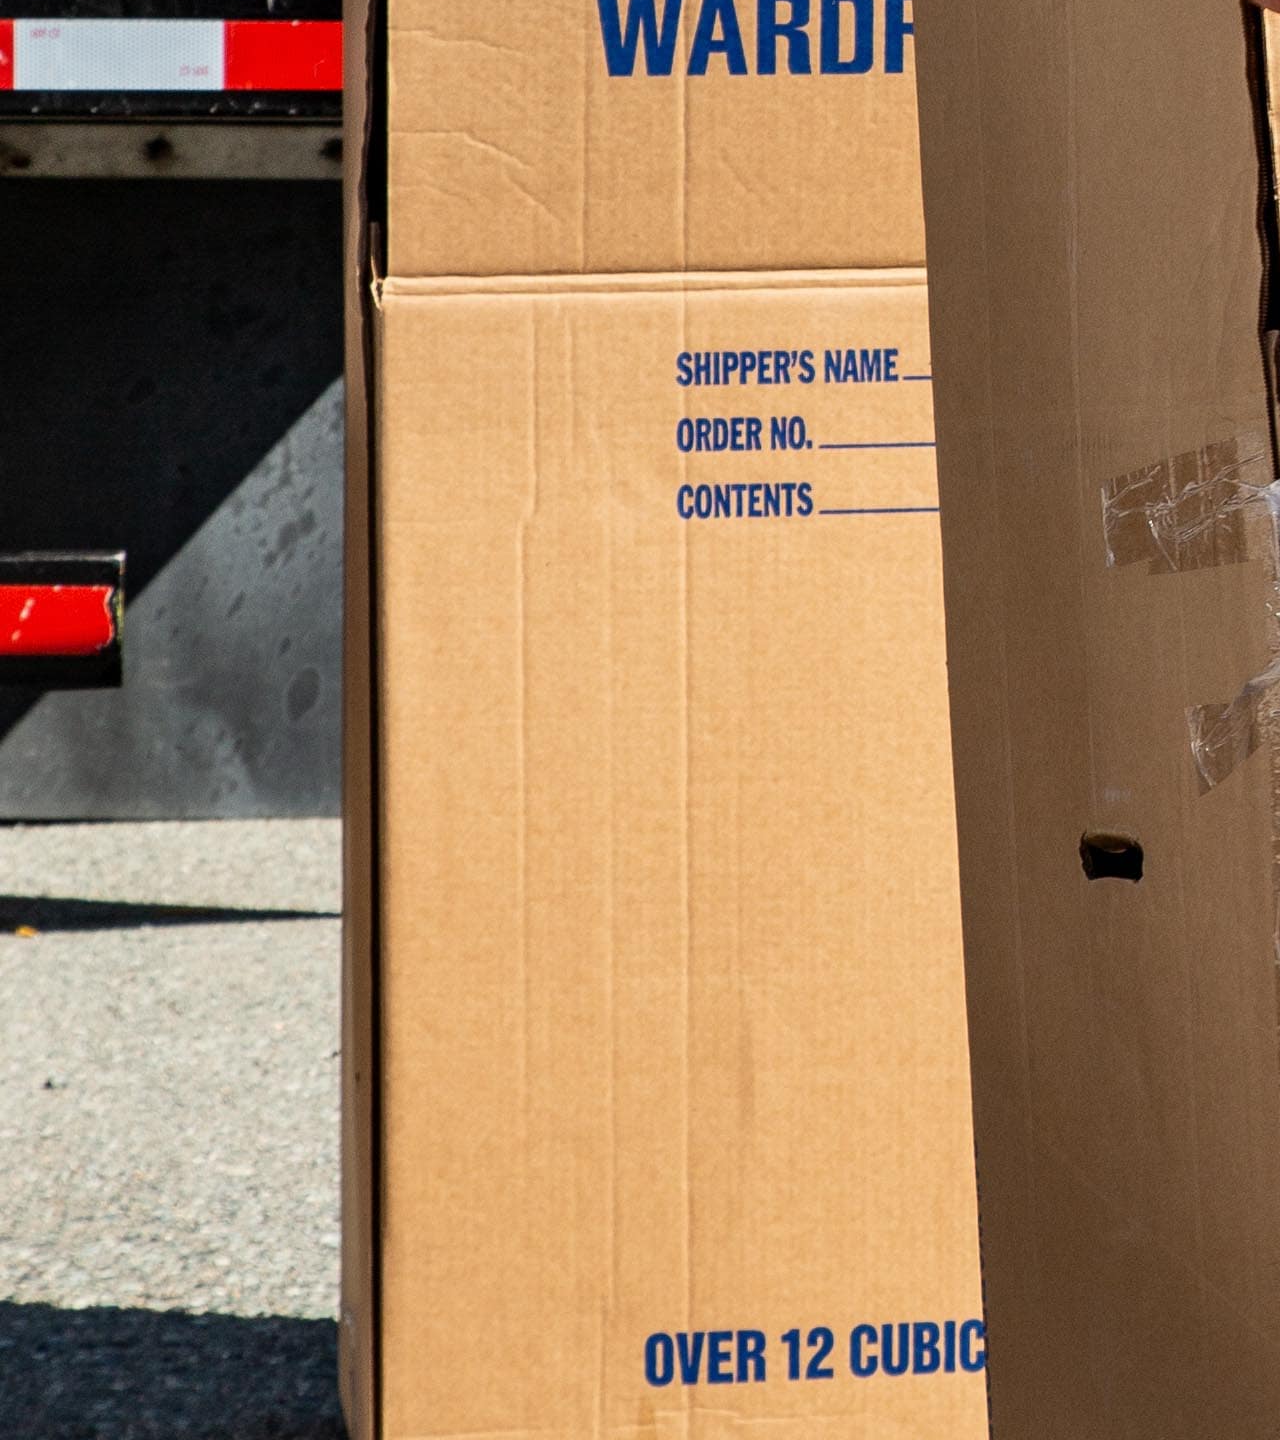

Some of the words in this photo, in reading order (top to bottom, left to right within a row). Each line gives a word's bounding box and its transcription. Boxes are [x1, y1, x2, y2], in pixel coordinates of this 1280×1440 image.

[676, 349, 816, 387] SHIPPER'S
[824, 348, 899, 383] NAME
[676, 417, 762, 453] ORDER
[770, 416, 813, 450] NO.
[676, 482, 814, 520] CONTENTS
[645, 1331, 766, 1387] OVER
[781, 1327, 834, 1381] 12
[850, 1319, 987, 1378] CUBIC
